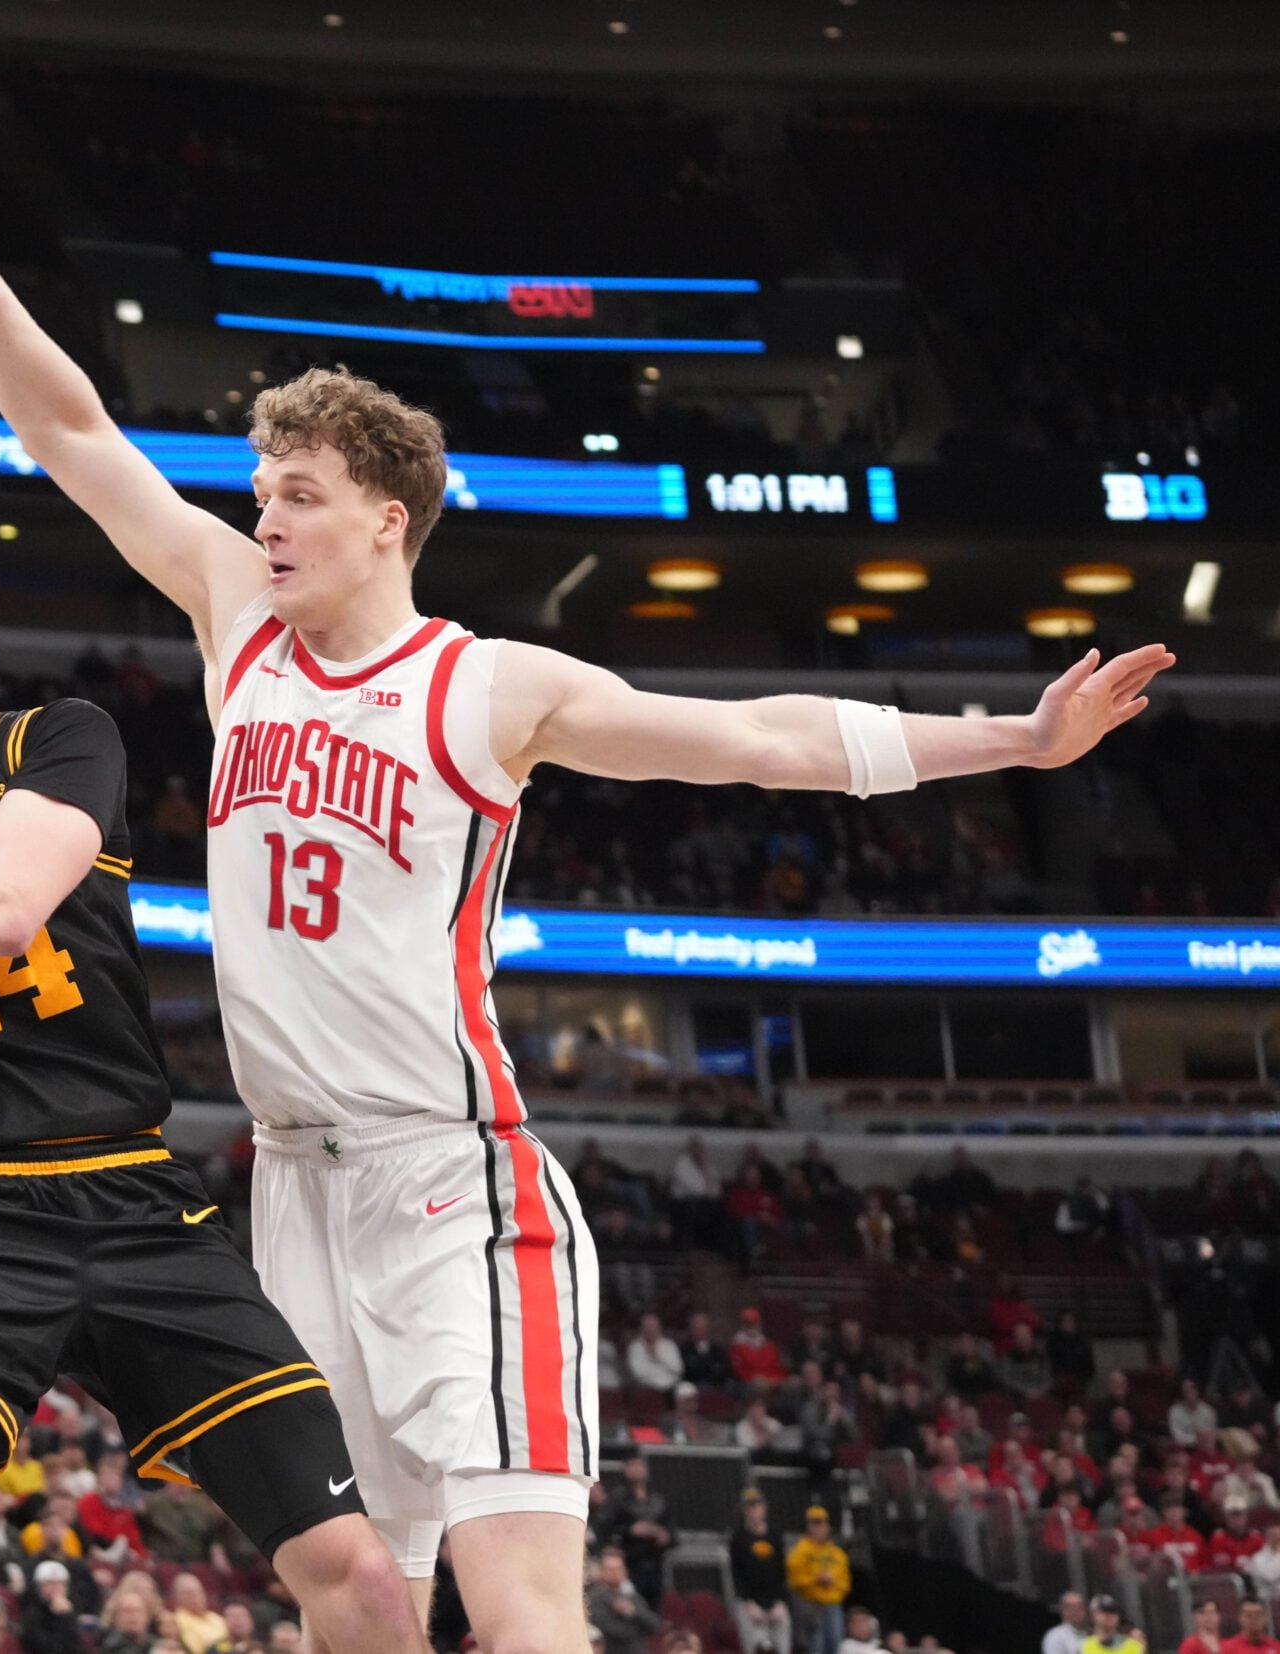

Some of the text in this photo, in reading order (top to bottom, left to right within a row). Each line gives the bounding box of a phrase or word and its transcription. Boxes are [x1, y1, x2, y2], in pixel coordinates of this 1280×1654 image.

[705, 473, 848, 512] 1:01 PM
[264, 832, 344, 942] 13
